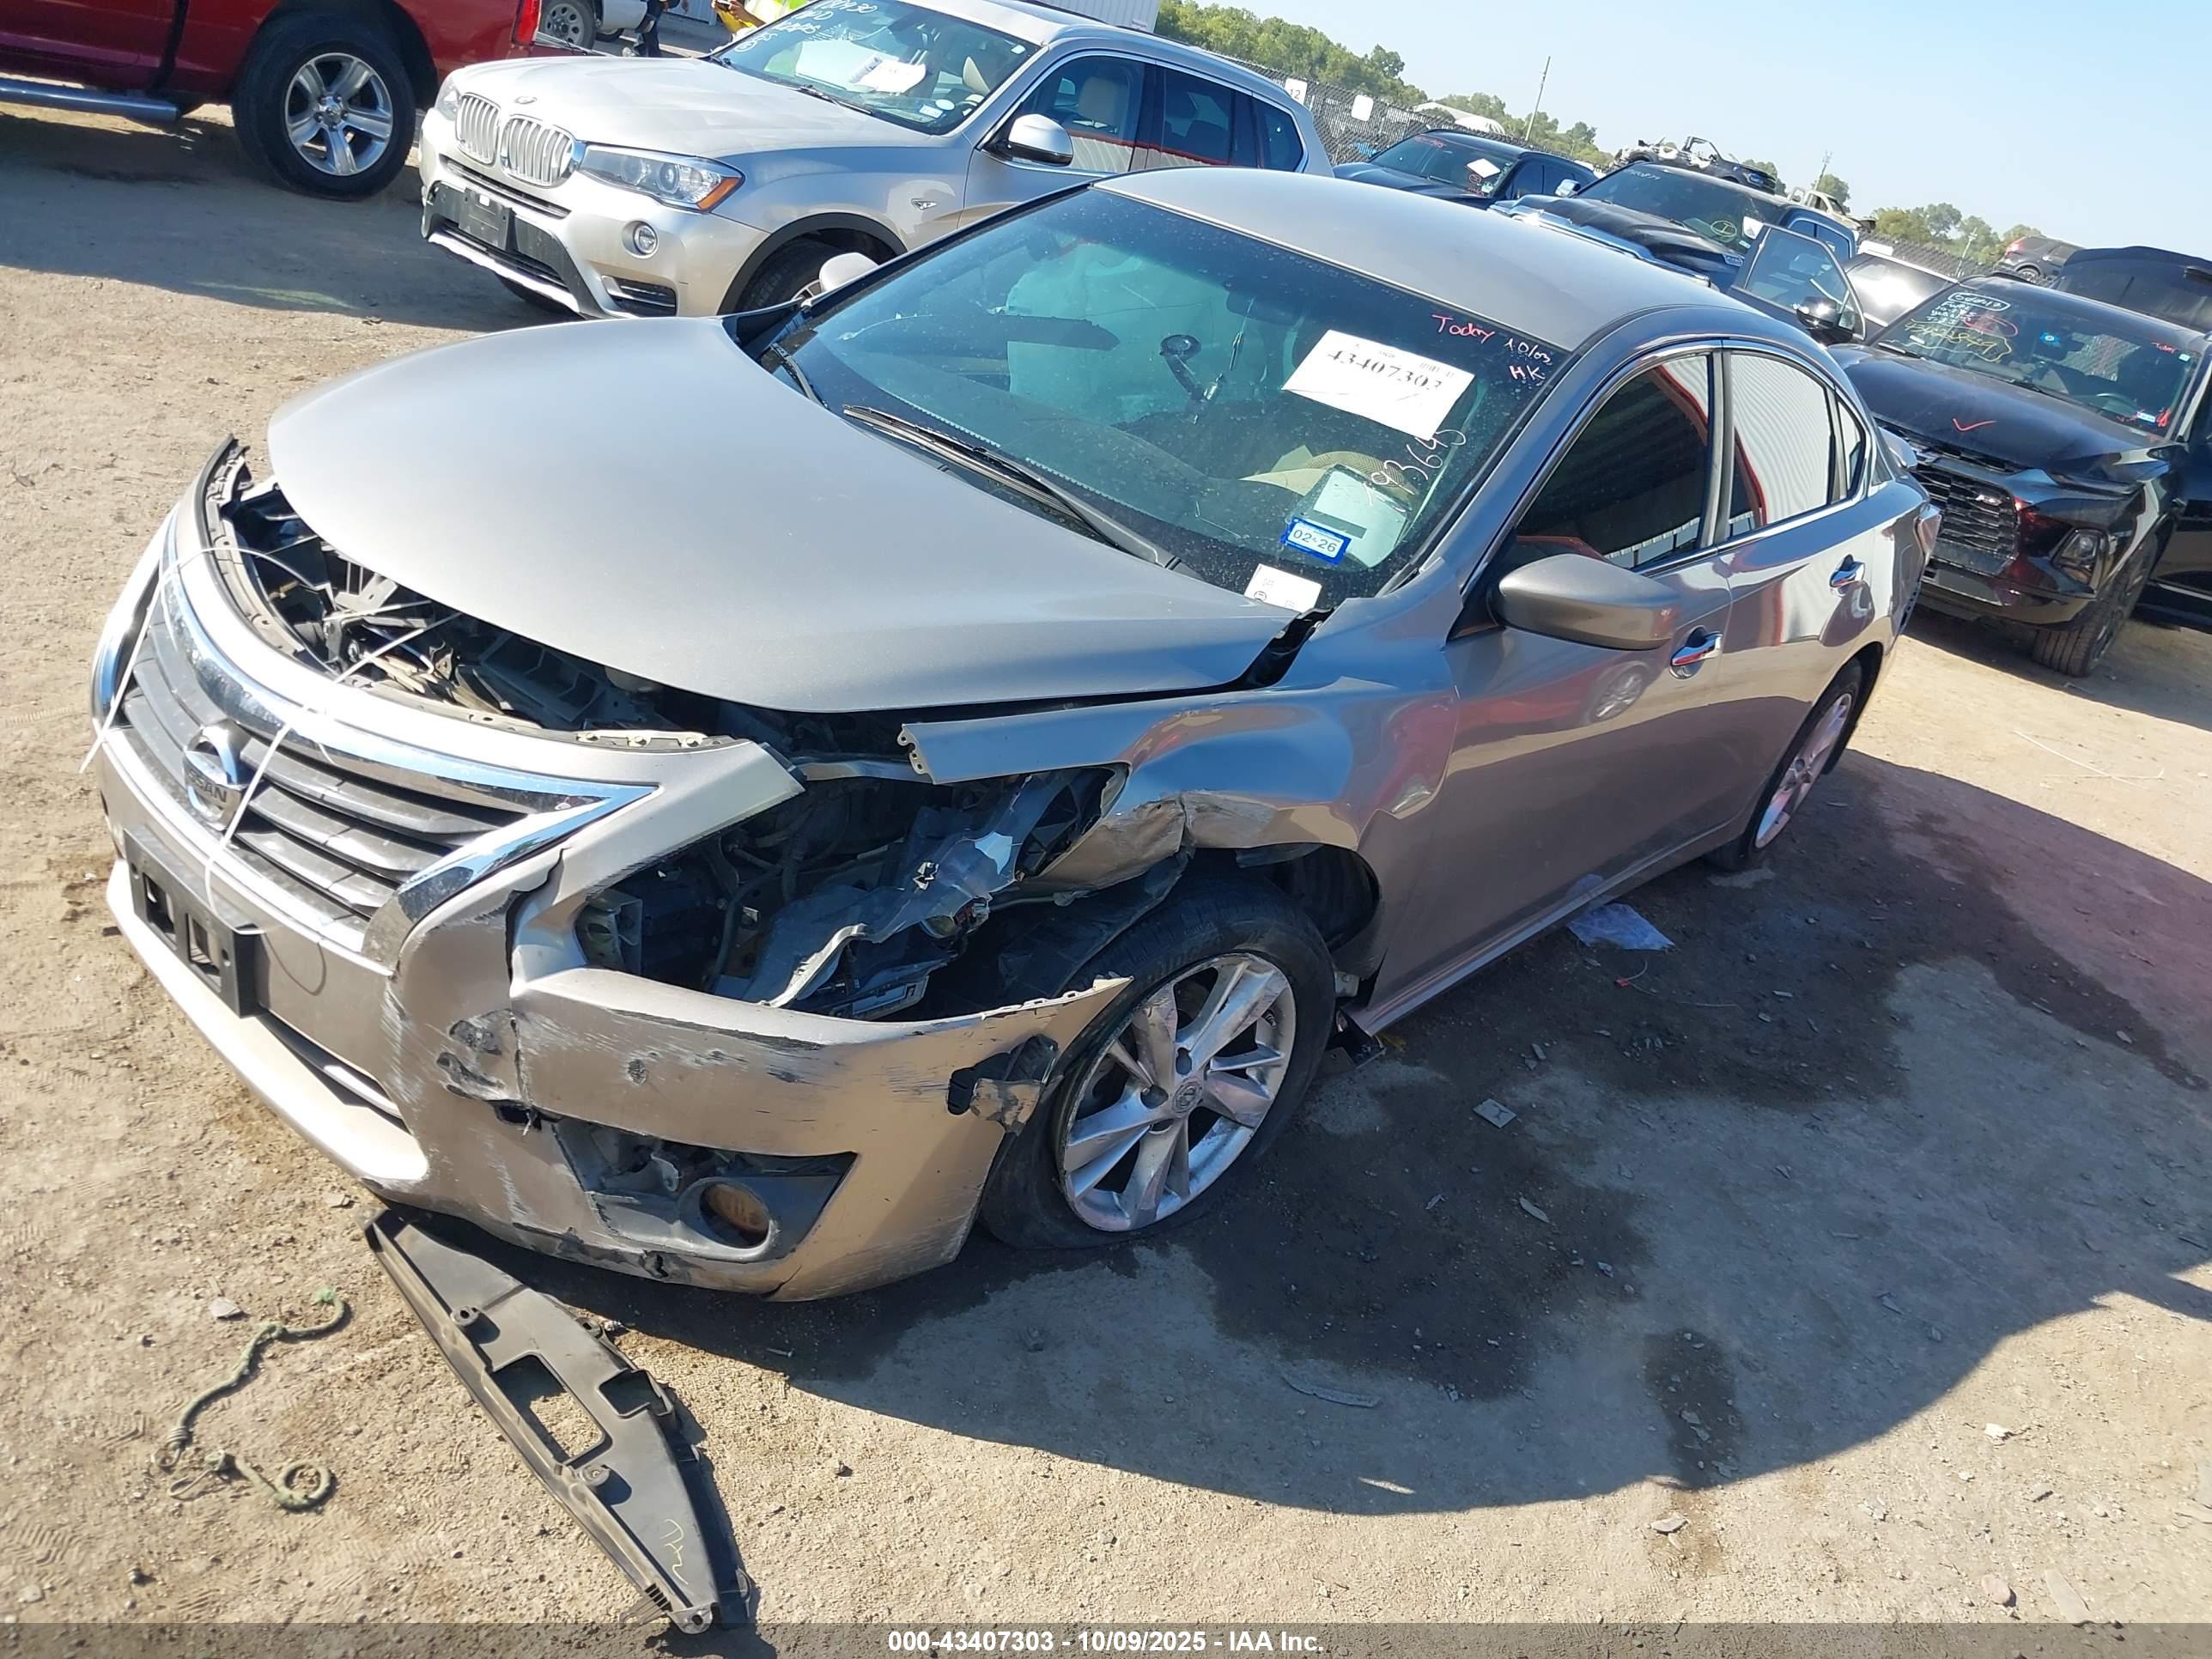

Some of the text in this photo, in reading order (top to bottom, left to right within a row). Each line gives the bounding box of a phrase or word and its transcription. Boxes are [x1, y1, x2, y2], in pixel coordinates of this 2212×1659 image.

[1289, 88, 1301, 100] 12
[1431, 314, 1553, 366] Today 10/03
[1327, 349, 1443, 390] 43407303
